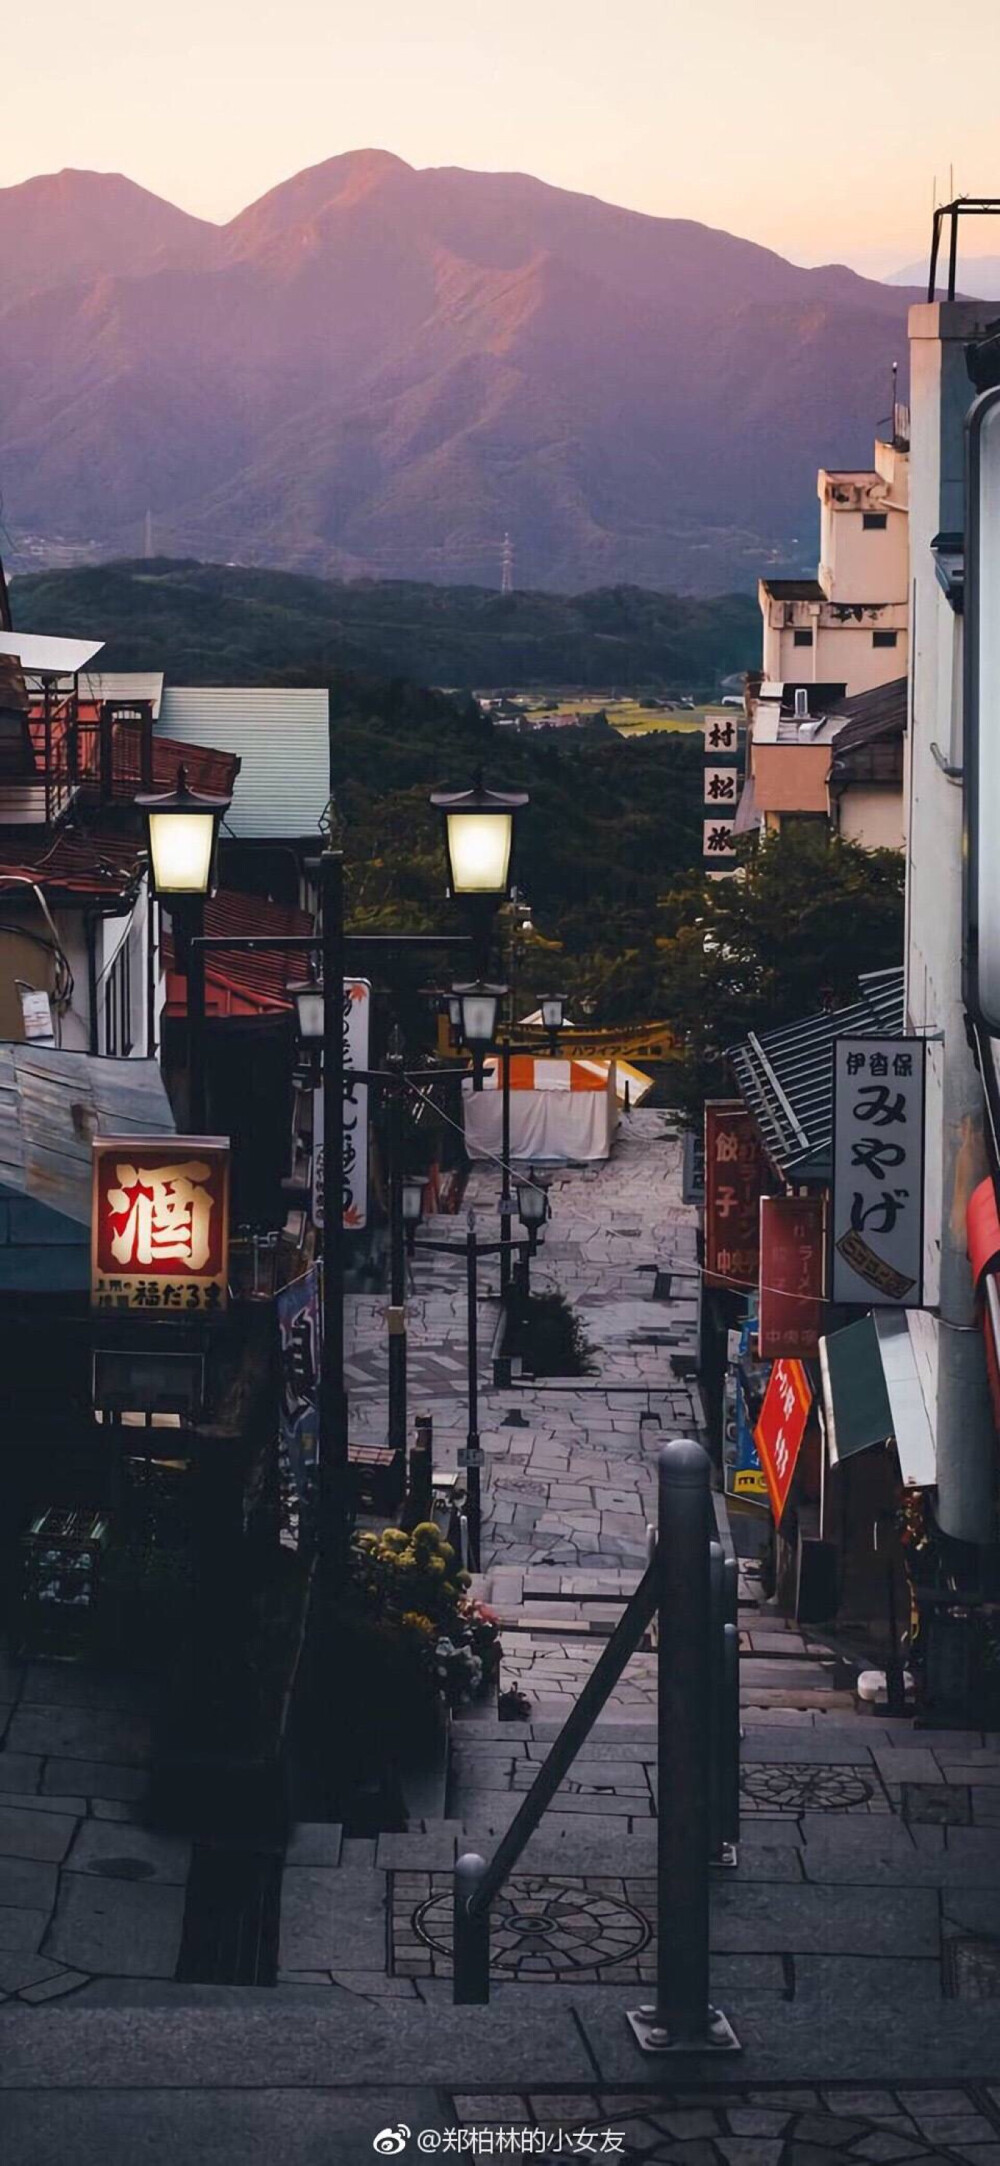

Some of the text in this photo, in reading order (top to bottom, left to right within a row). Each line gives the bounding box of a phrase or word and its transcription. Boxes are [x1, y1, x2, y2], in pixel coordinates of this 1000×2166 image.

[846, 1051, 913, 1078] 伊香保
[851, 1084, 910, 1234] みやげ
[107, 1160, 214, 1270] 酒
[133, 1280, 221, 1309] 福だるま
